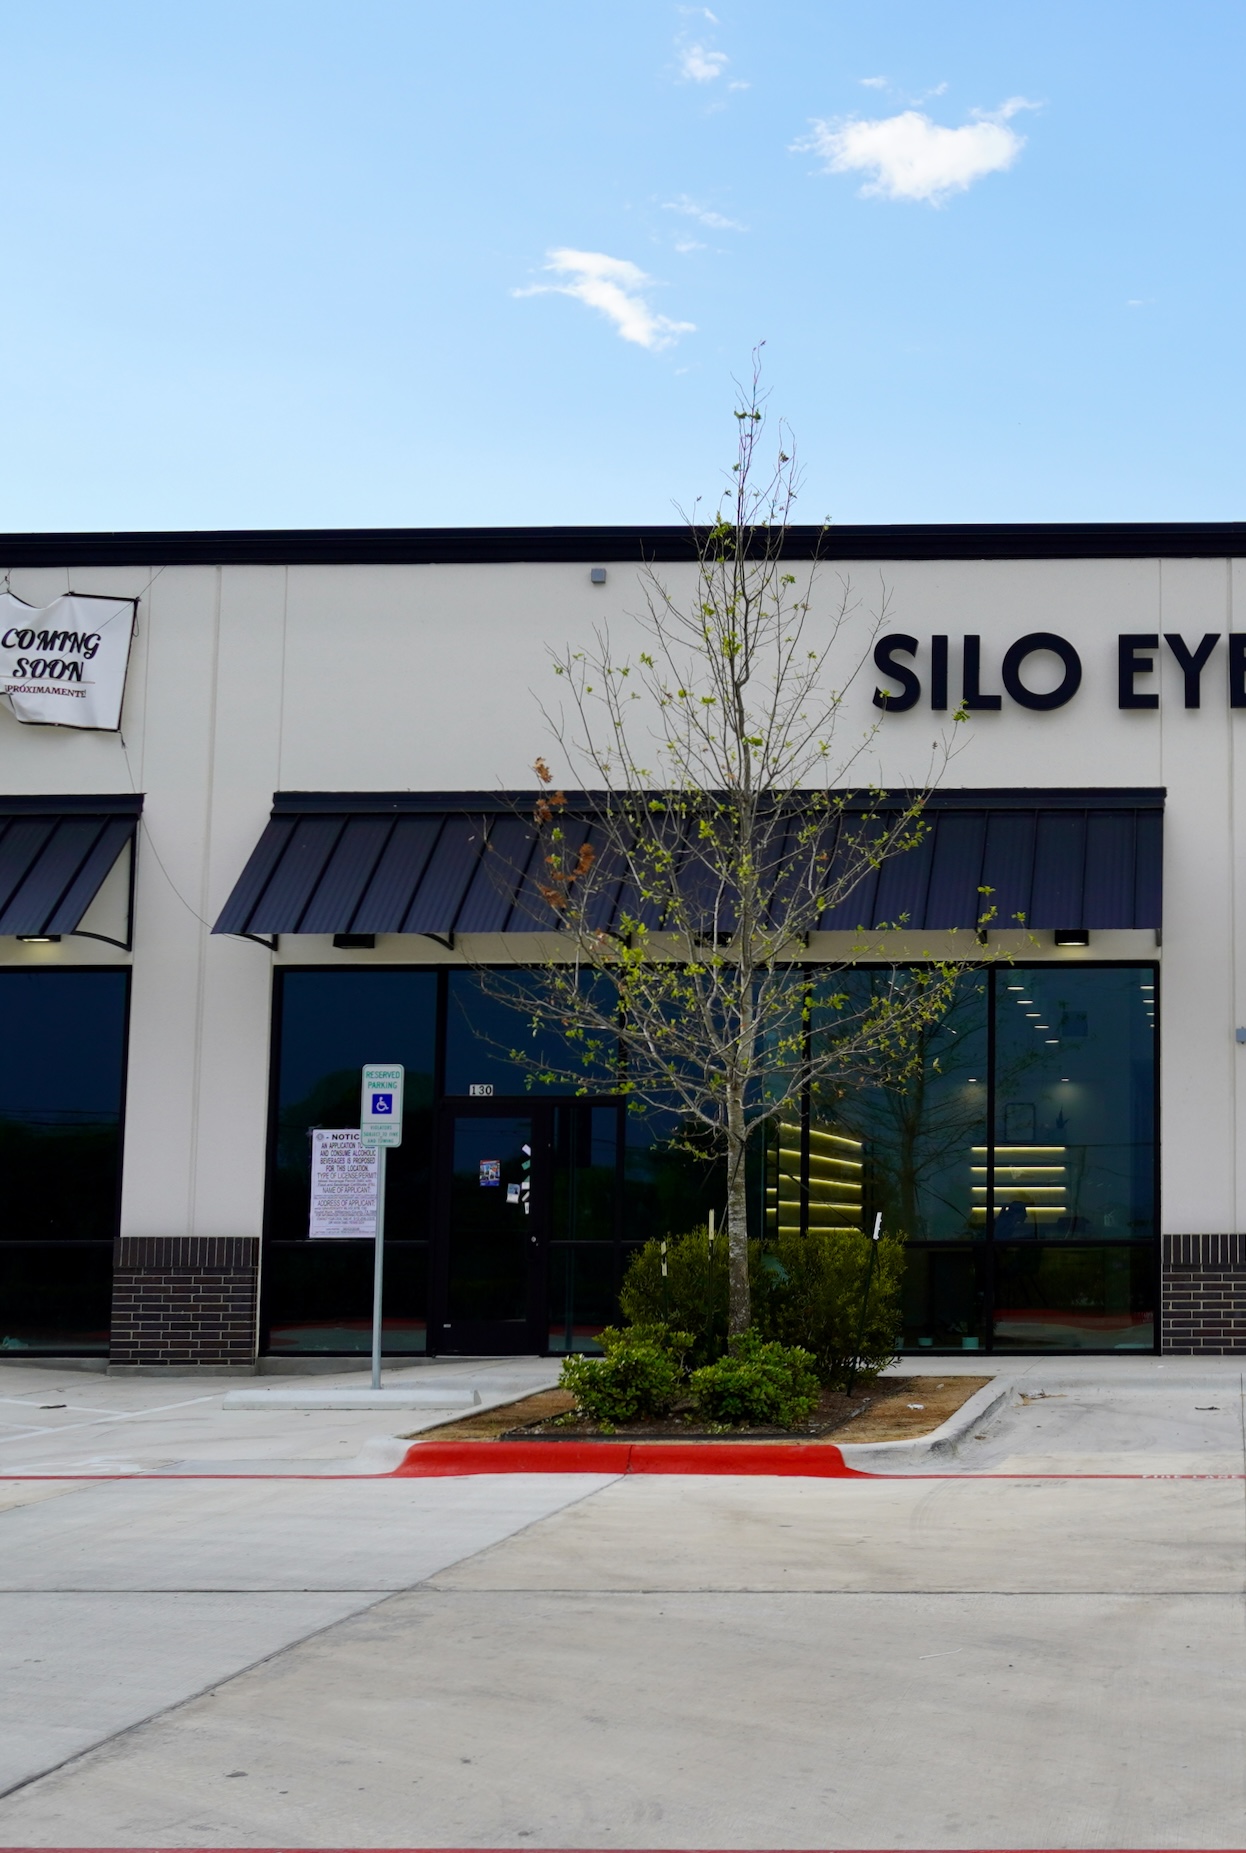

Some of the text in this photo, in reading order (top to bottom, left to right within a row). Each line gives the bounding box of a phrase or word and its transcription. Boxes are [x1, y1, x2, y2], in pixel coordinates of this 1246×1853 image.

[1, 628, 102, 660] COMING
[12, 657, 84, 682] SOON
[872, 633, 1082, 712] SILO
[366, 1071, 400, 1079] RESERVED
[367, 1081, 398, 1089] PARKING
[471, 1085, 492, 1095] 130
[352, 1149, 376, 1157] ALCOHOLIC
[352, 1157, 376, 1165] PROPOSED
[322, 1186, 336, 1194] NAME
[336, 1186, 344, 1194] OF
